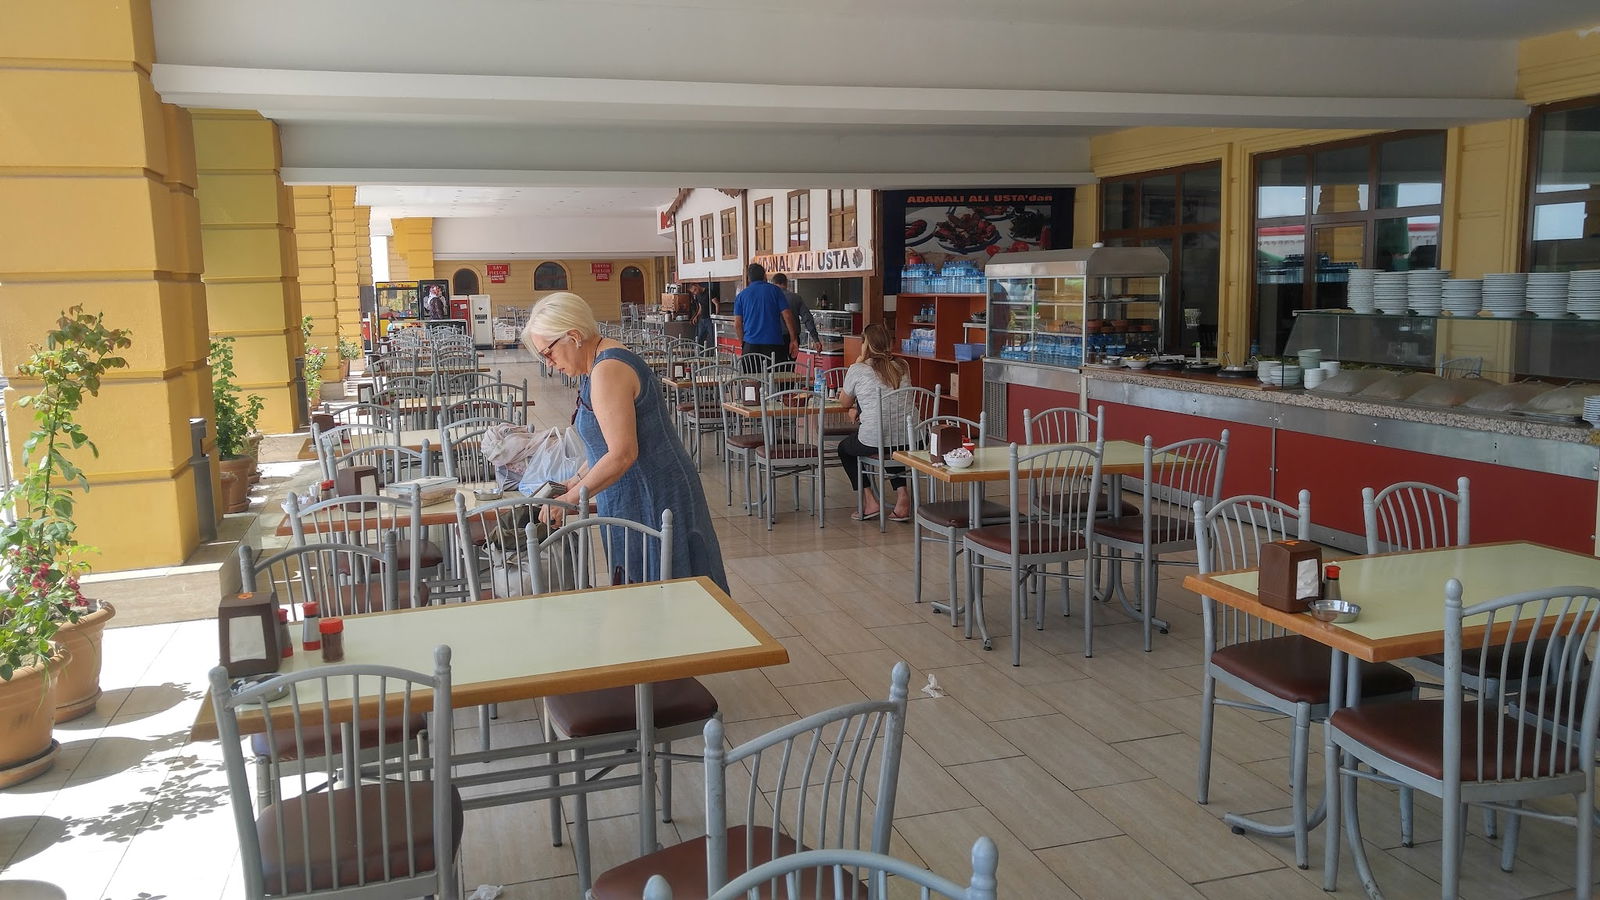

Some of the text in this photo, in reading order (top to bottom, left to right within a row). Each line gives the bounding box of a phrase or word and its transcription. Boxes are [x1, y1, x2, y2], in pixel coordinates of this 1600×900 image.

[906, 194, 1054, 203] ADANALI ALI USTA'dan
[817, 249, 850, 270] USTA
